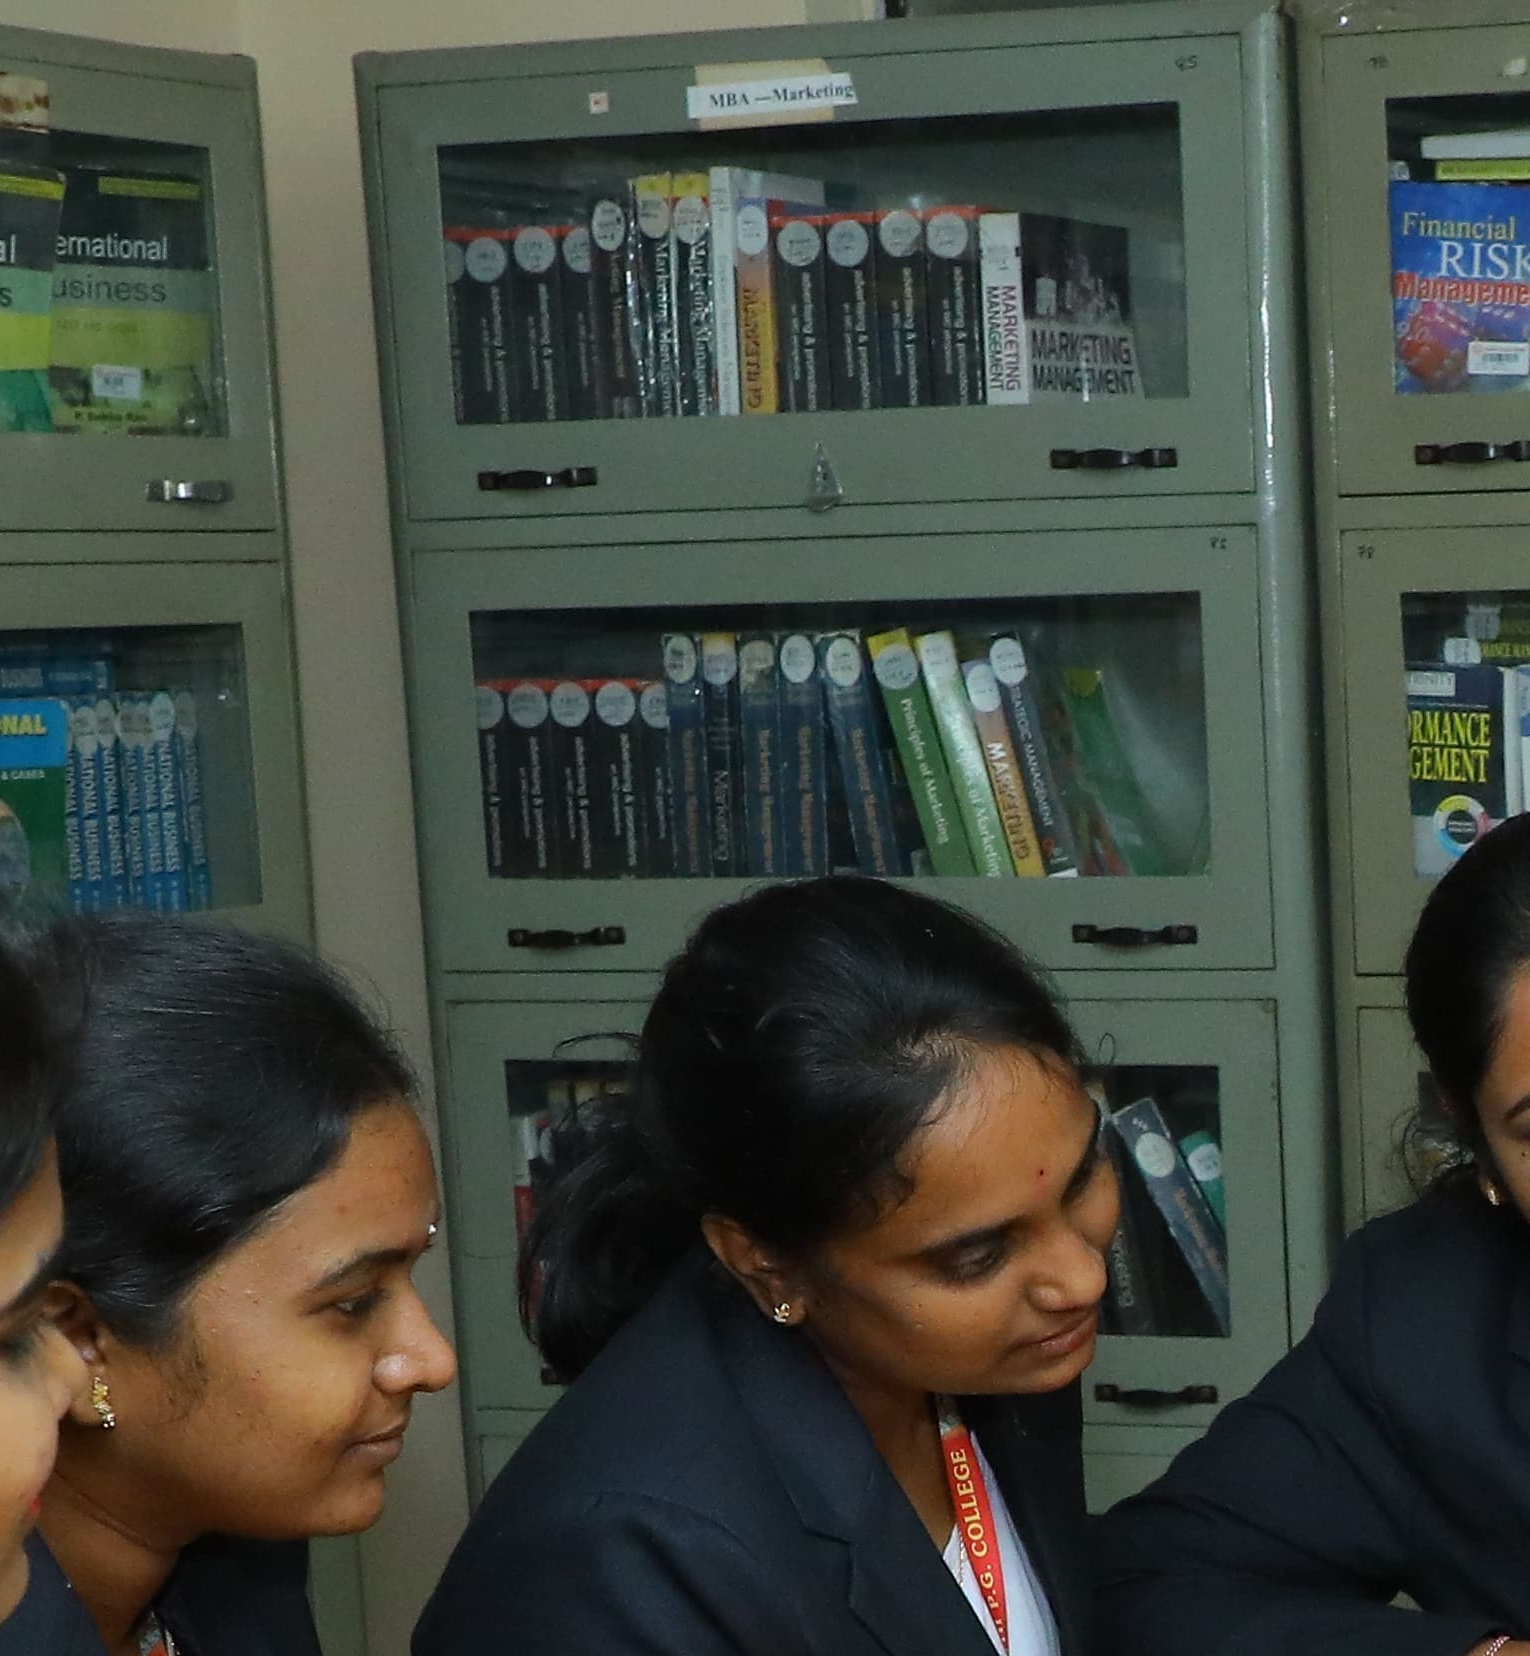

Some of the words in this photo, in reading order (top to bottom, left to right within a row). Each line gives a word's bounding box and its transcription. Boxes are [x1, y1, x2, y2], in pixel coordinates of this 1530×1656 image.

[710, 92, 750, 109] MBA
[1402, 211, 1516, 242] Financial
[55, 233, 168, 261] ernational
[52, 275, 167, 303] usiness
[985, 285, 1004, 391] MANAGEMENT
[1003, 285, 1021, 392] MARKETING
[1031, 329, 1133, 365] MARKETING
[1410, 747, 1488, 783] GEMENT
[714, 770, 729, 861] Marketing
[950, 1447, 988, 1557] COLLEGE
